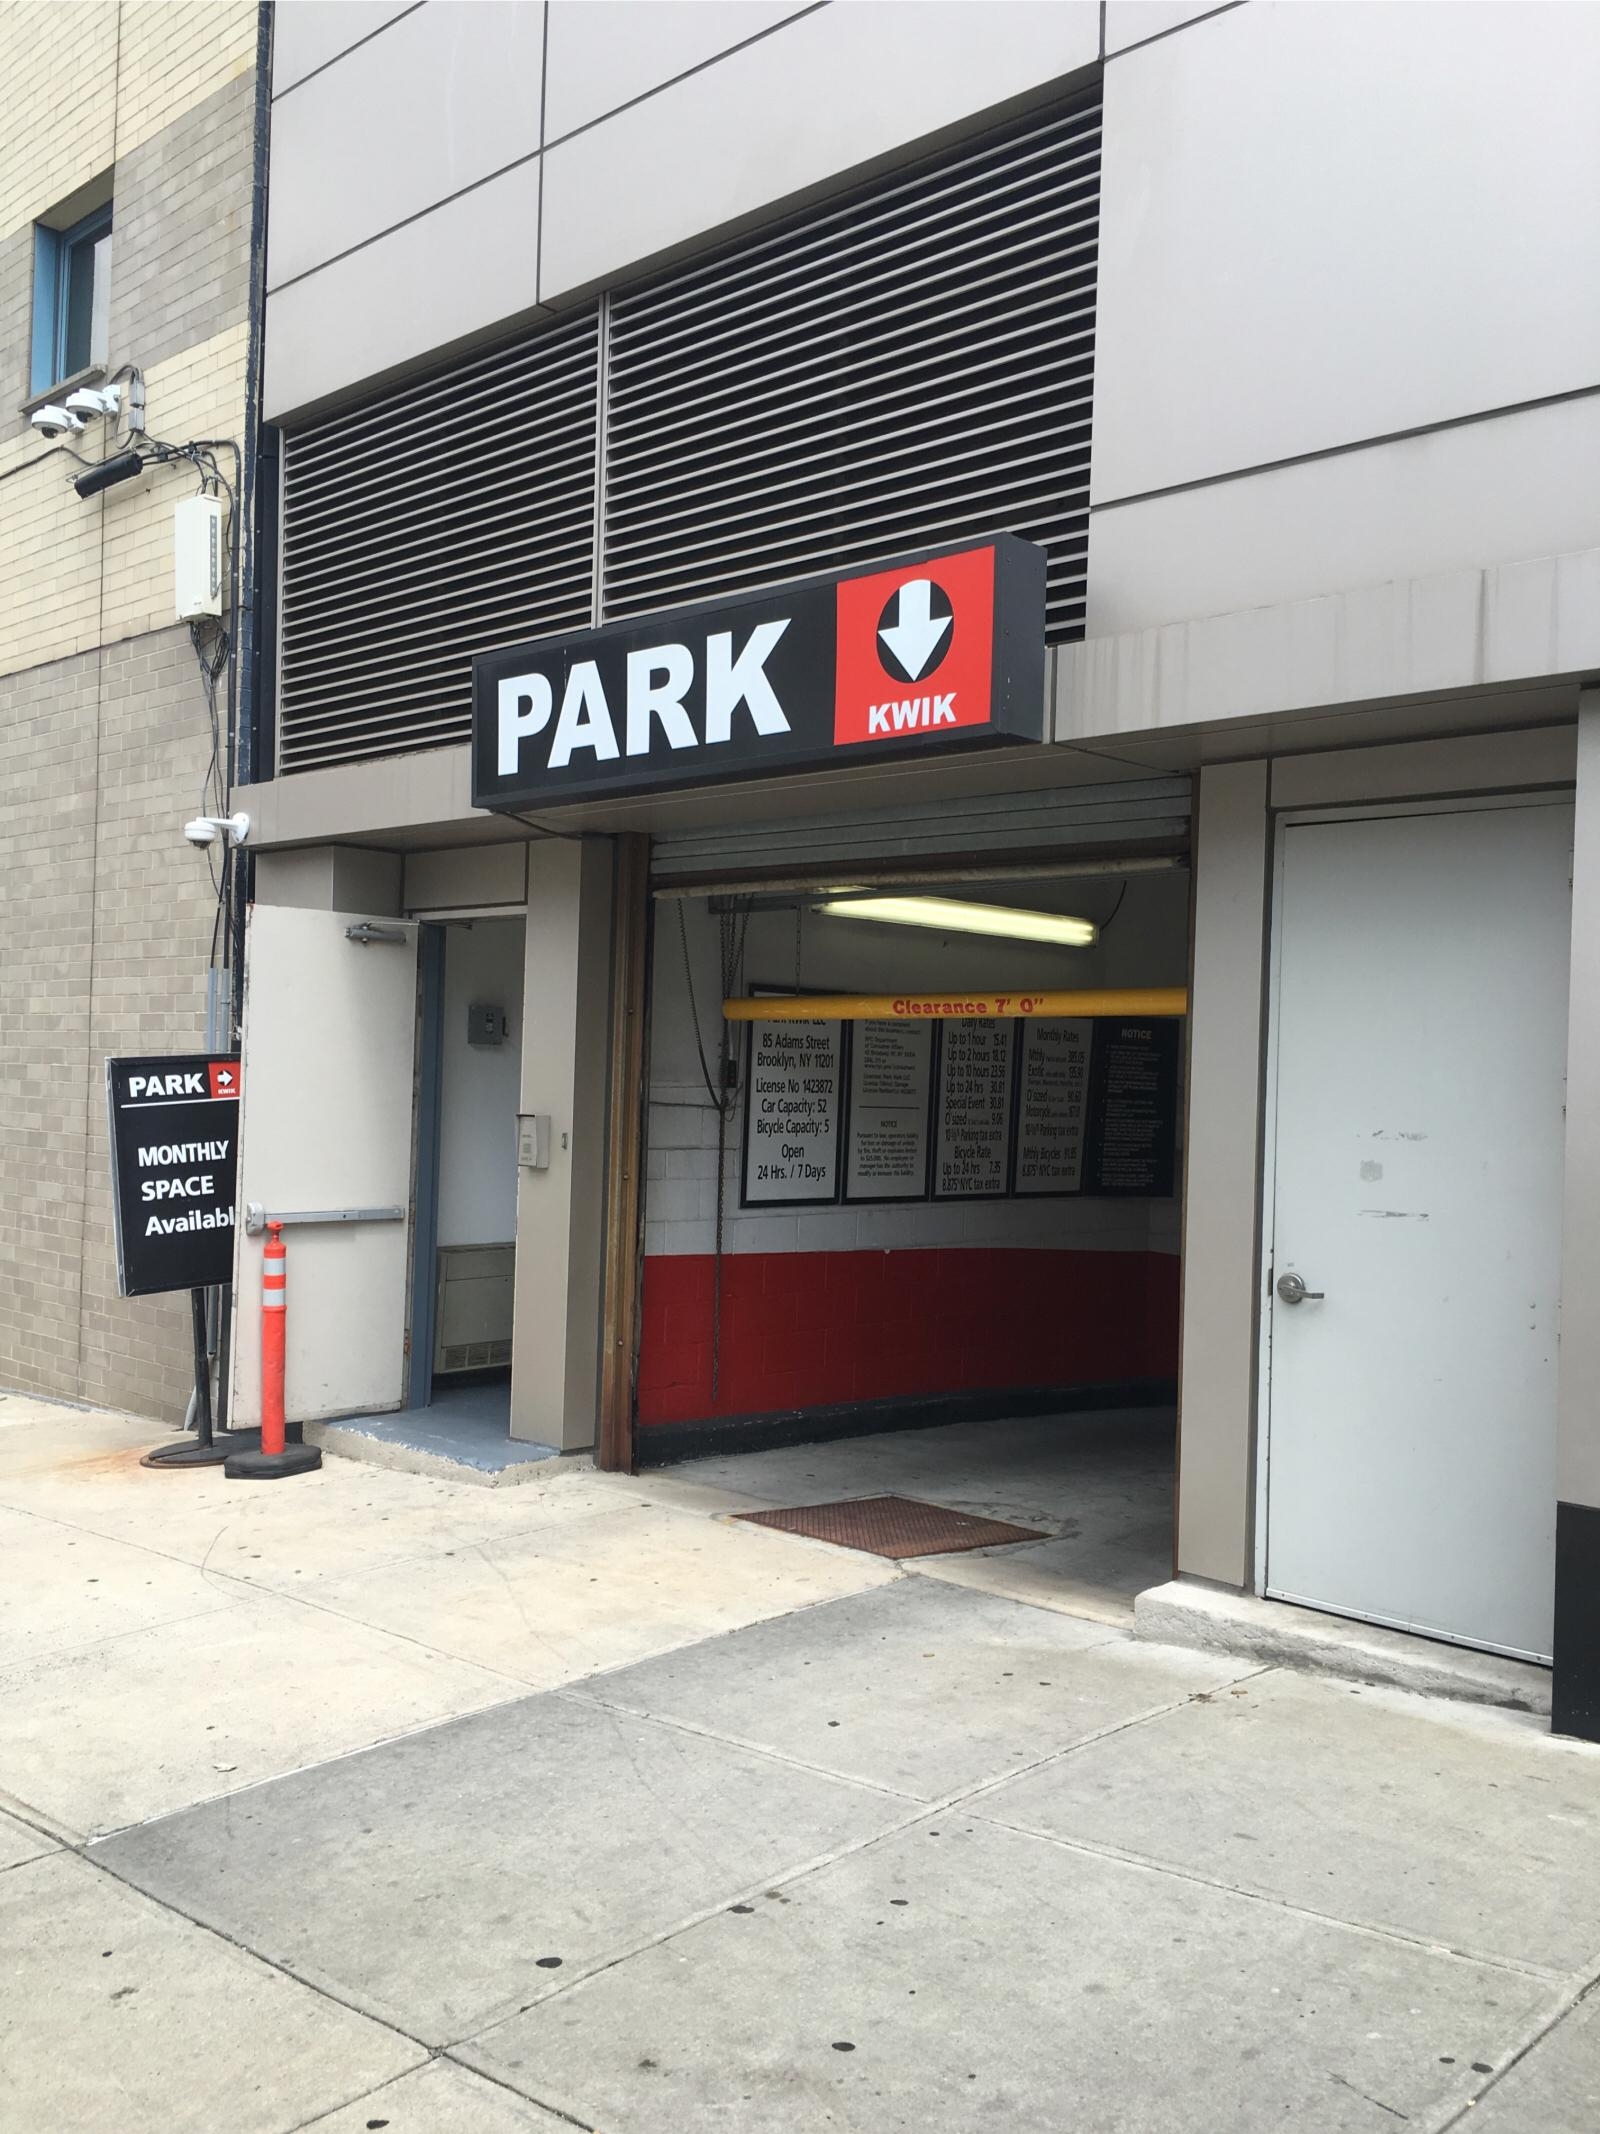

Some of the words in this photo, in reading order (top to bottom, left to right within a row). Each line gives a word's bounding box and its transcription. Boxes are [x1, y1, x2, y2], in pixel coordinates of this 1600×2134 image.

[497, 617, 792, 777] PARK
[868, 692, 957, 734] KWIK
[892, 999, 987, 1014] Clearance
[995, 998, 1011, 1013] 7'
[762, 1032, 773, 1048] 85
[775, 1032, 804, 1049] Adams
[805, 1034, 830, 1050] Street
[948, 1031, 957, 1048] Up
[959, 1032, 967, 1045] to
[972, 1031, 986, 1046] hour
[1063, 1029, 1080, 1043] Rates
[1121, 1027, 1153, 1040] NOTICE
[757, 1051, 796, 1071] Brooklyn,
[799, 1053, 812, 1068] NY
[815, 1053, 834, 1068] 11201
[947, 1047, 957, 1064] Up
[958, 1049, 966, 1061] to
[967, 1048, 972, 1062] 2
[973, 1048, 990, 1062] hours
[946, 1063, 956, 1081] Up
[957, 1065, 965, 1077] to
[972, 1063, 990, 1078] hours
[128, 1072, 205, 1098] PARK
[756, 1077, 786, 1093] License
[788, 1079, 800, 1093] No
[802, 1079, 833, 1094] 1423872
[946, 1079, 956, 1096] Up
[956, 1081, 965, 1094] to
[965, 1080, 973, 1094] 24
[974, 1079, 984, 1094] hrs
[761, 1098, 776, 1113] Car
[777, 1097, 816, 1117] Capacity:
[817, 1098, 827, 1113] 52
[945, 1095, 967, 1112] Special
[967, 1096, 985, 1110] Event
[757, 1118, 784, 1138] Bicycle
[785, 1118, 822, 1137] Capacity:
[824, 1119, 830, 1134] 5
[951, 1112, 967, 1126] sized
[138, 1140, 229, 1167] MONTHLY
[781, 1144, 805, 1162] Open
[954, 1144, 976, 1162] Bicycle
[976, 1145, 992, 1159] Rate
[757, 1165, 769, 1180] 24
[770, 1164, 787, 1180] Hrs.
[797, 1164, 803, 1178] 7
[804, 1163, 826, 1181] Days
[942, 1161, 952, 1178] Up
[953, 1162, 961, 1175] to
[961, 1160, 969, 1175] 24
[970, 1160, 980, 1174] hrs
[141, 1175, 215, 1202] SPACE
[960, 1177, 973, 1191] NYC
[973, 1178, 984, 1190] tax
[984, 1178, 1001, 1190] extra
[145, 1205, 235, 1236] Availabl
